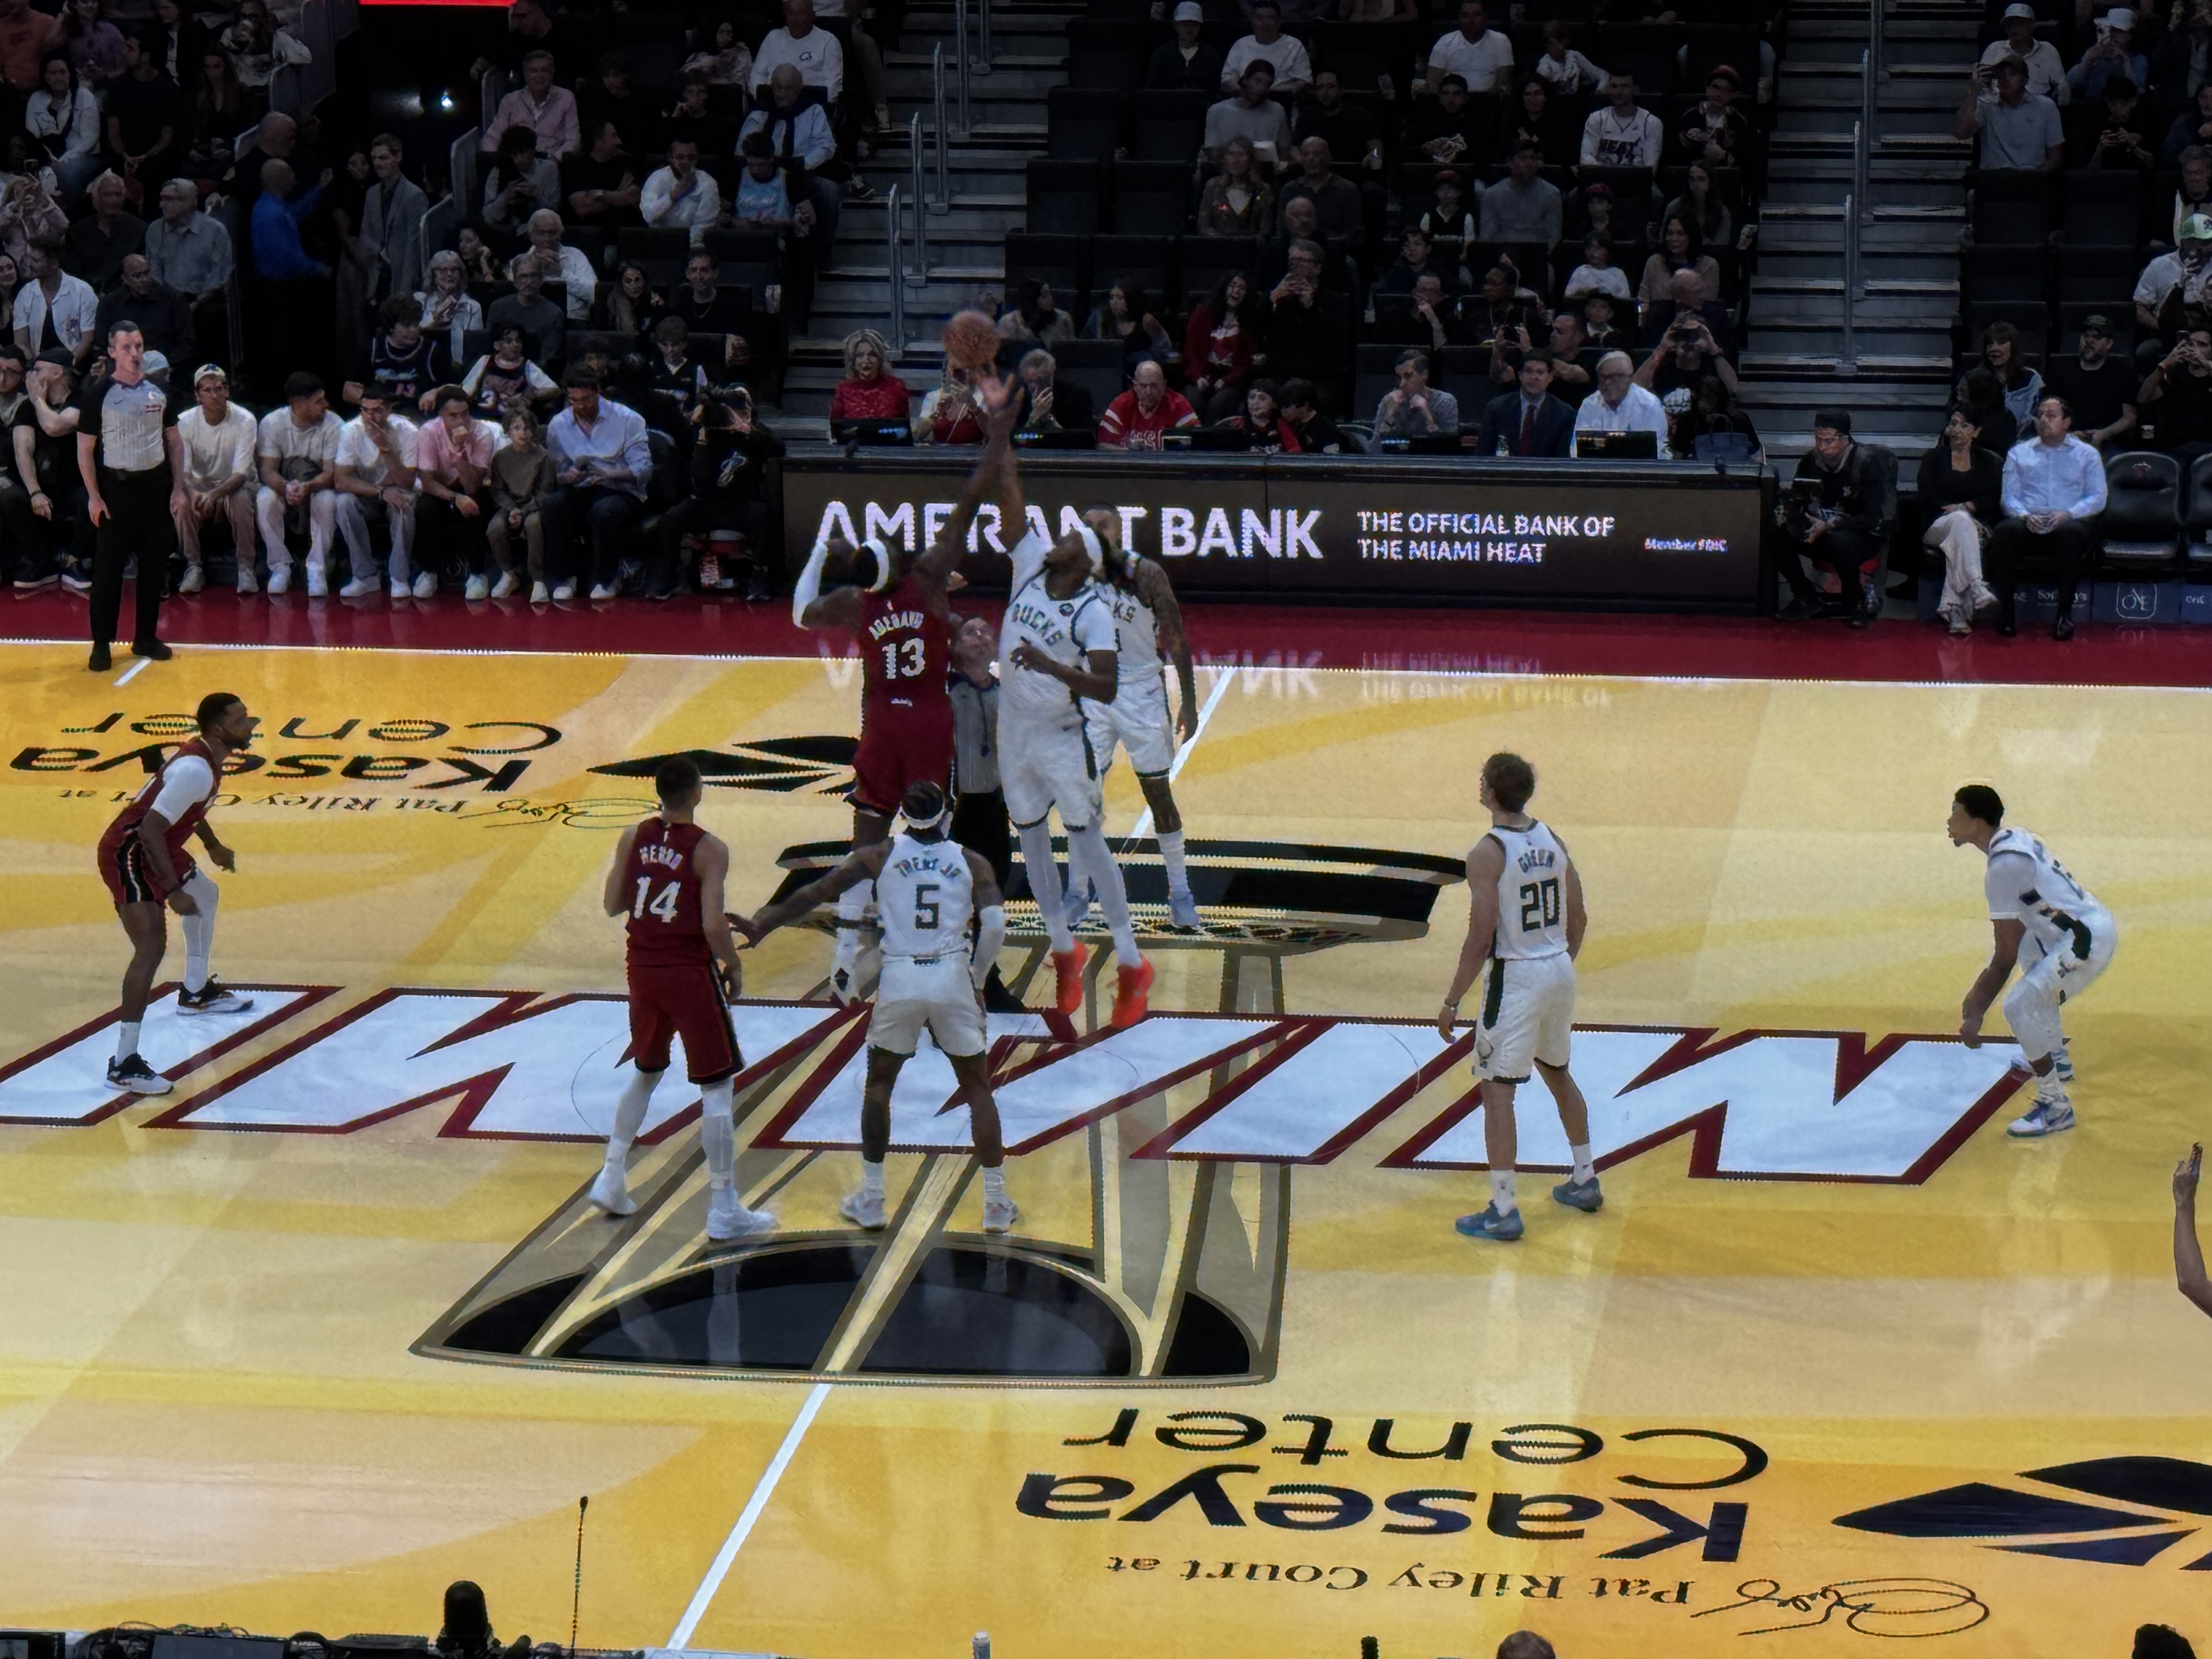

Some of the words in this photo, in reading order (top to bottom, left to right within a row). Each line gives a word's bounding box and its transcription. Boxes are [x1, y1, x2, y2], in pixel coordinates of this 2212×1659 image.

[1160, 506, 1324, 559] BANK
[1357, 511, 1403, 533] THE
[1408, 512, 1510, 535] OFFICIAL
[1514, 514, 1579, 536] BANK
[1584, 516, 1616, 537] OF
[1357, 538, 1403, 560] THE
[1409, 540, 1480, 561] MIAMI
[1487, 543, 1547, 563] HEAT
[882, 637, 926, 679] 13
[60, 712, 562, 755] Cener
[252, 792, 382, 810] Riley
[395, 797, 471, 812] Pat
[634, 876, 681, 923] 14
[915, 884, 940, 929] 5
[1520, 877, 1560, 932] 20
[1061, 1408, 1769, 1491] Center
[1016, 1463, 1750, 1563] Kaseya
[1106, 1555, 1161, 1573] at
[1182, 1558, 1369, 1592] Court
[1389, 1561, 1573, 1601] Riley
[1588, 1576, 1697, 1605] Pat
